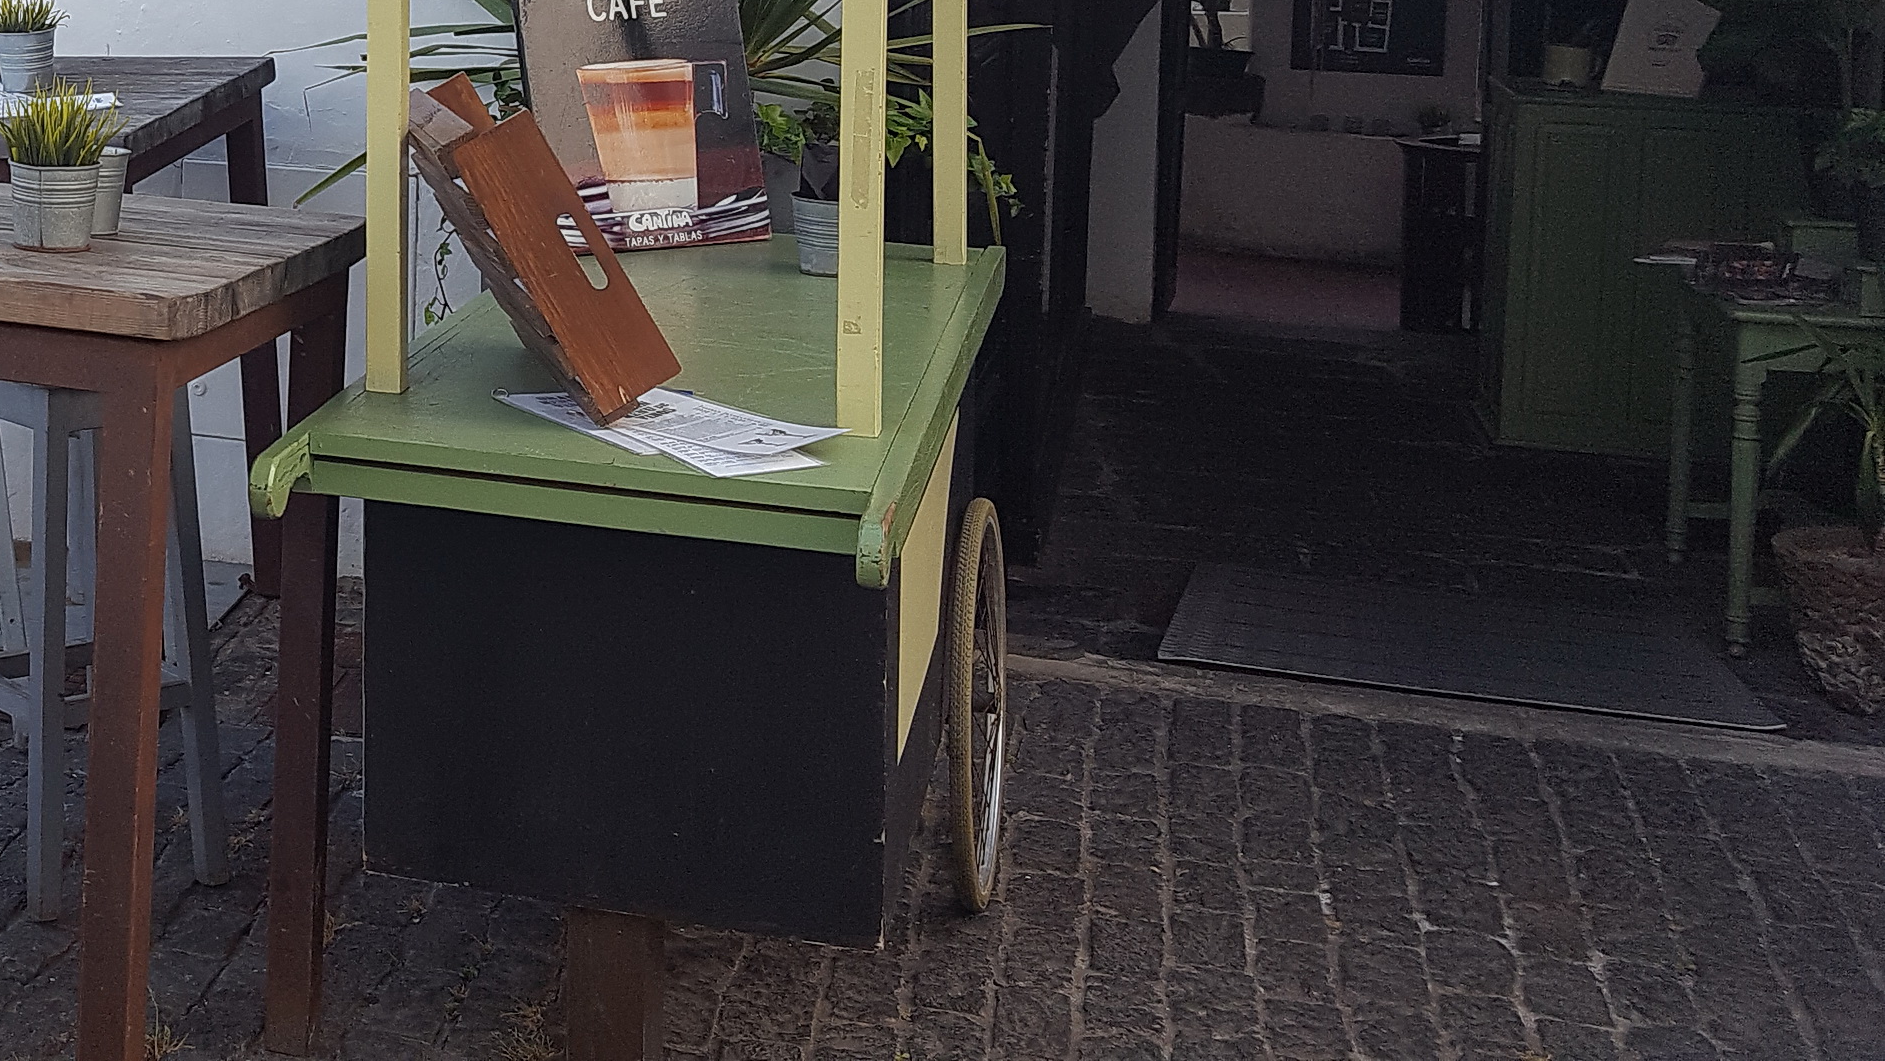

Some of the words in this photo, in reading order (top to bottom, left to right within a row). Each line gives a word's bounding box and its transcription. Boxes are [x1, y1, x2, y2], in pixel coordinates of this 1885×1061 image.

[625, 236, 655, 247] TAPAS
[658, 235, 665, 243] Y
[667, 230, 703, 244] TABLAS
